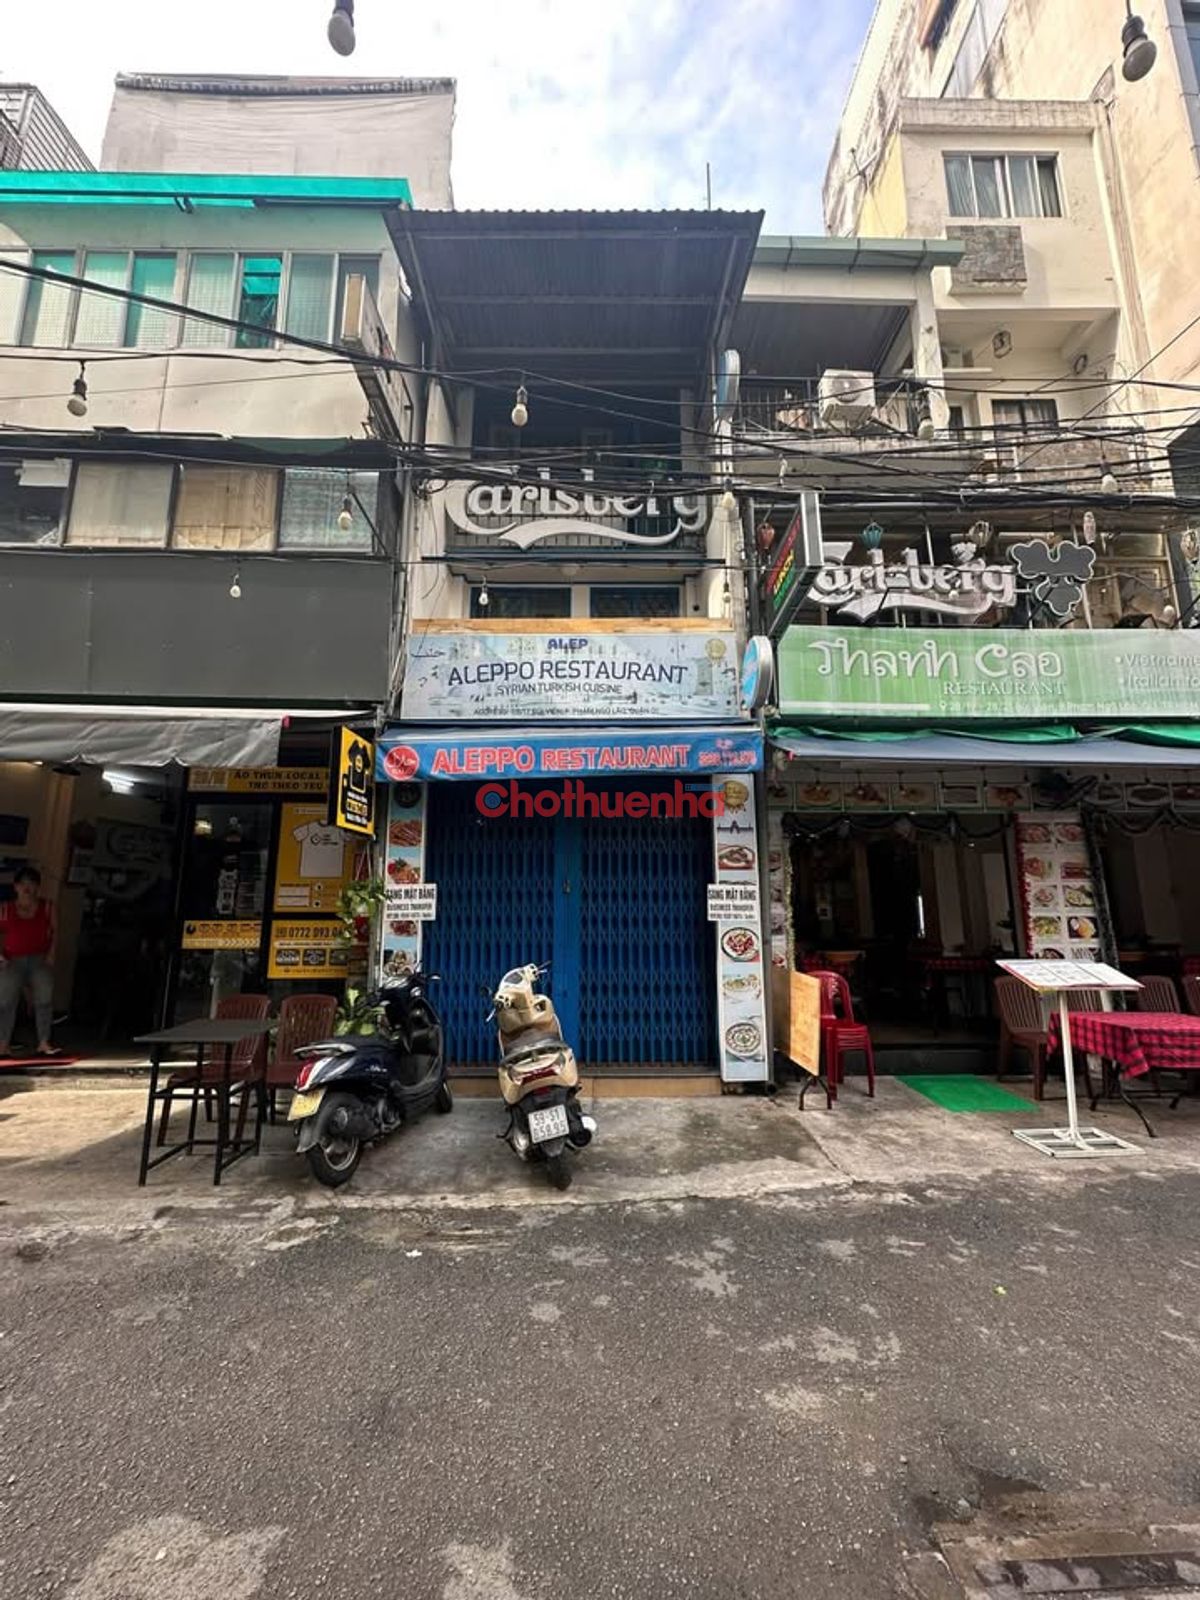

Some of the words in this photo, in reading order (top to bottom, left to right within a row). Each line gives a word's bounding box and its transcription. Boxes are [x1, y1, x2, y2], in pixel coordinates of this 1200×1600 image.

[807, 542, 1017, 608] Carlberg
[808, 638, 960, 678] Thanh
[974, 643, 1063, 678] Cao
[448, 661, 535, 687] ALEPPO
[539, 660, 689, 685] RESTAURANT
[496, 682, 536, 695] SYRIAN
[538, 681, 581, 693] TURKISH
[582, 683, 623, 695] CUISINE
[943, 681, 1067, 696] RESTAURANT
[430, 745, 536, 776] ALEPPO
[540, 744, 692, 771] RESTAURANT
